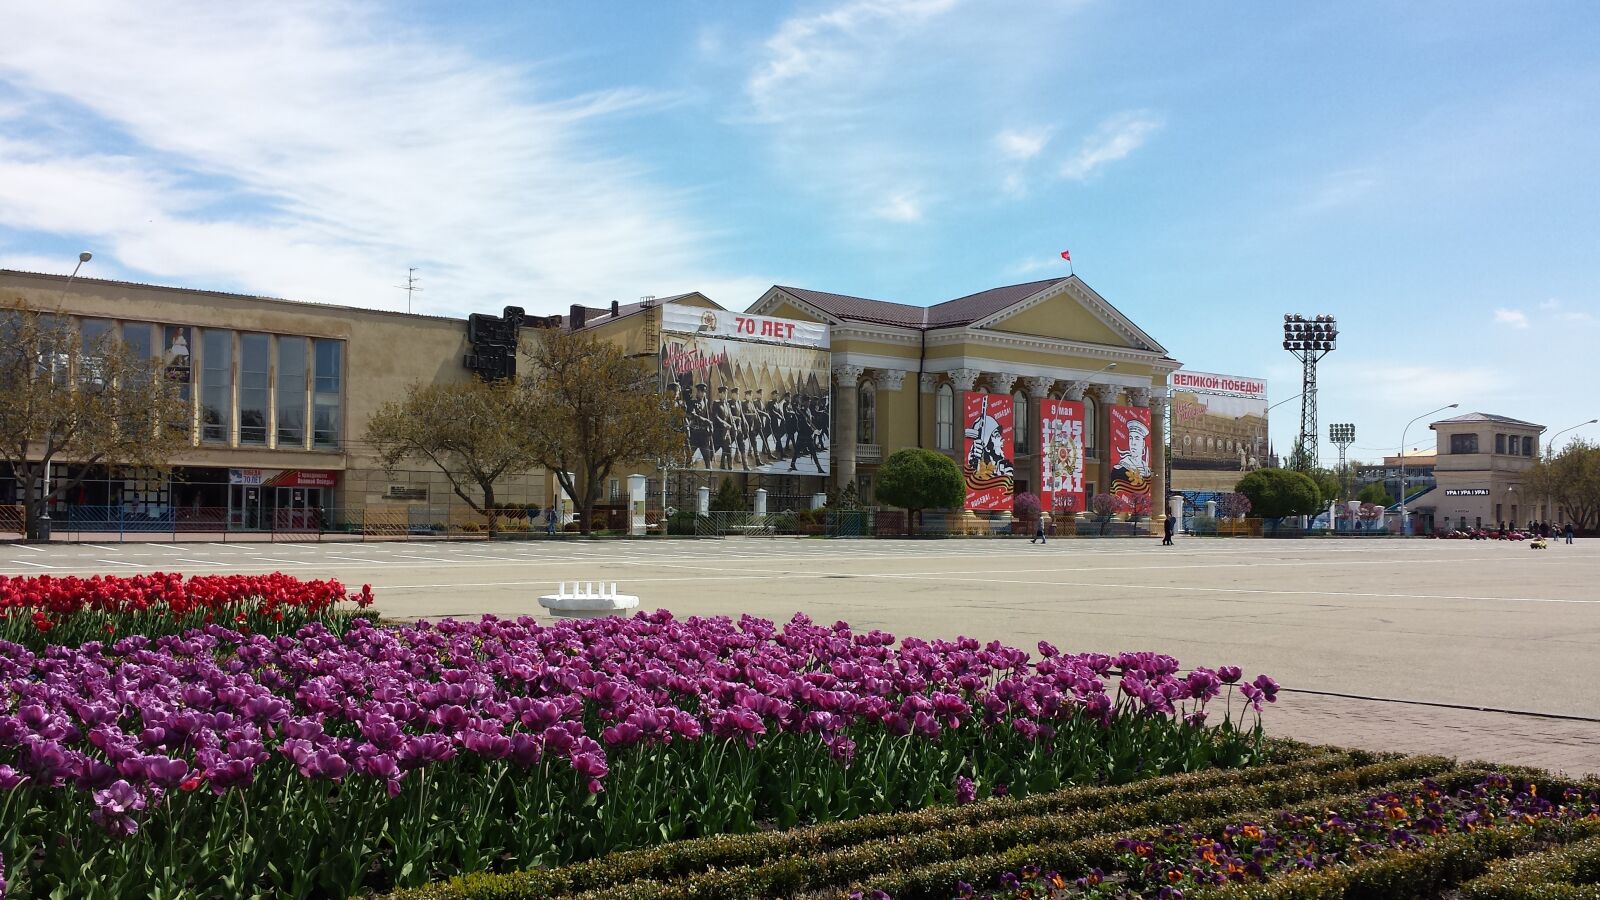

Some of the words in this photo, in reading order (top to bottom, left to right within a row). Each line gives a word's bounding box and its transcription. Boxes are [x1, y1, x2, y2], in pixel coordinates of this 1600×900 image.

[735, 317, 756, 335] 70
[760, 320, 795, 339] ЛЕТ
[1174, 374, 1218, 388] ВЕЛИКОЙ
[1221, 379, 1264, 394] ПОБЕДЫ!
[1051, 405, 1056, 414] 9
[1058, 407, 1073, 416] мая
[243, 475, 251, 483] 70
